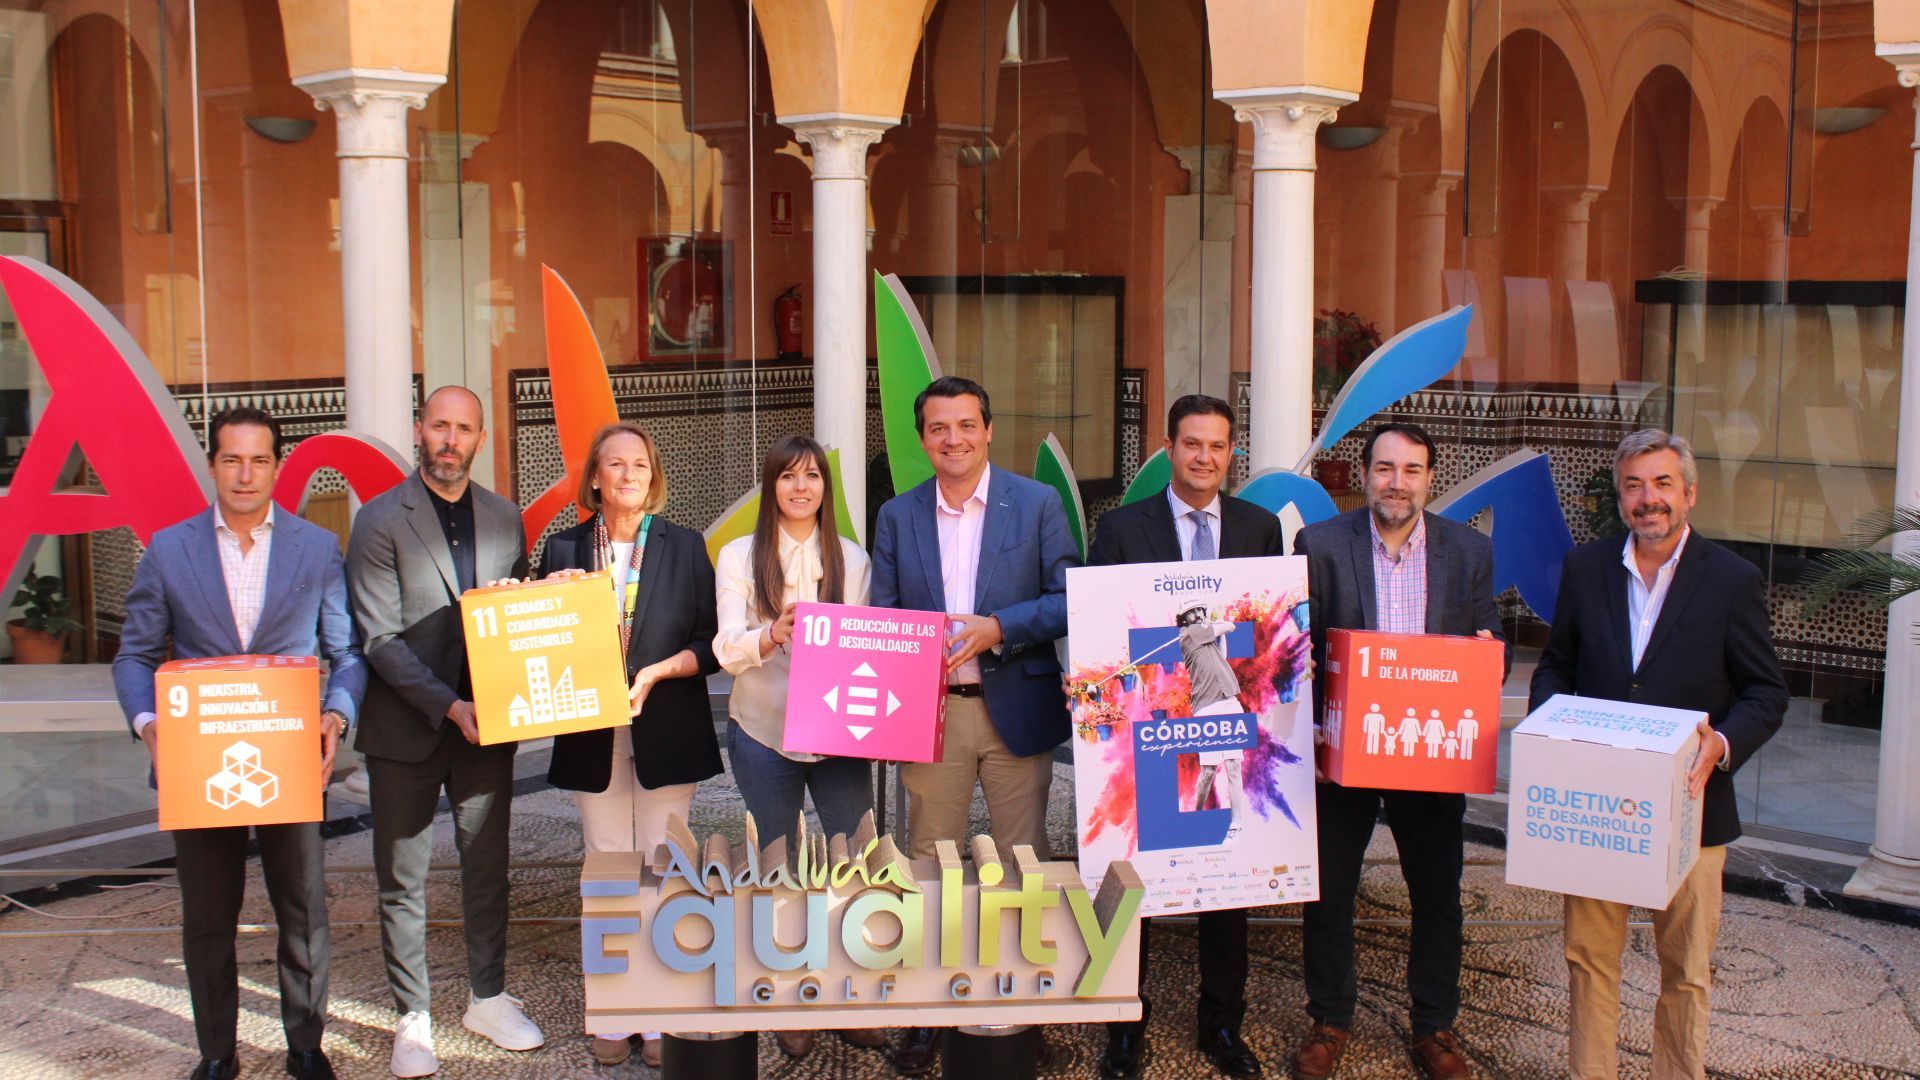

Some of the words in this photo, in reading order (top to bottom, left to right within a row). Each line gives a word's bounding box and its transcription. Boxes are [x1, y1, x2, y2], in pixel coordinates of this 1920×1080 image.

[1154, 575, 1222, 595] Equality
[504, 598, 554, 616] CIUDADES
[554, 597, 563, 610] Y
[471, 606, 498, 638] 11
[507, 613, 580, 634] COMUNIDADES
[802, 614, 831, 647] 10
[840, 617, 899, 634] REDUCCIÓN
[901, 623, 914, 636] DE
[917, 624, 936, 637] LAS
[508, 632, 574, 652] SOSTENIBLES
[839, 635, 920, 654] DESIGUALDADES
[1359, 646, 1370, 677] 1
[1380, 648, 1397, 661] FIN
[1379, 666, 1392, 679] DE
[1396, 667, 1408, 680] LA
[1411, 668, 1458, 683] POBREZA
[198, 682, 262, 697] INDUSTRIA,
[168, 685, 189, 717] 9
[199, 699, 269, 716] INNOVACIÓN
[271, 700, 278, 713] E
[199, 717, 304, 734] INFRAESTRUCTURA
[1140, 720, 1248, 742] CÓRDOBA
[1141, 737, 1248, 757] experience
[1526, 785, 1653, 819] OBJETIVOS
[1526, 805, 1545, 819] DE
[1550, 808, 1652, 836] DESARROLLO
[1525, 821, 1650, 855] SOSTENIBLE
[657, 824, 922, 897] Andalucía
[581, 858, 1145, 1006] Equality
[752, 976, 896, 1004] GOLF
[950, 973, 1055, 1000] CUP
